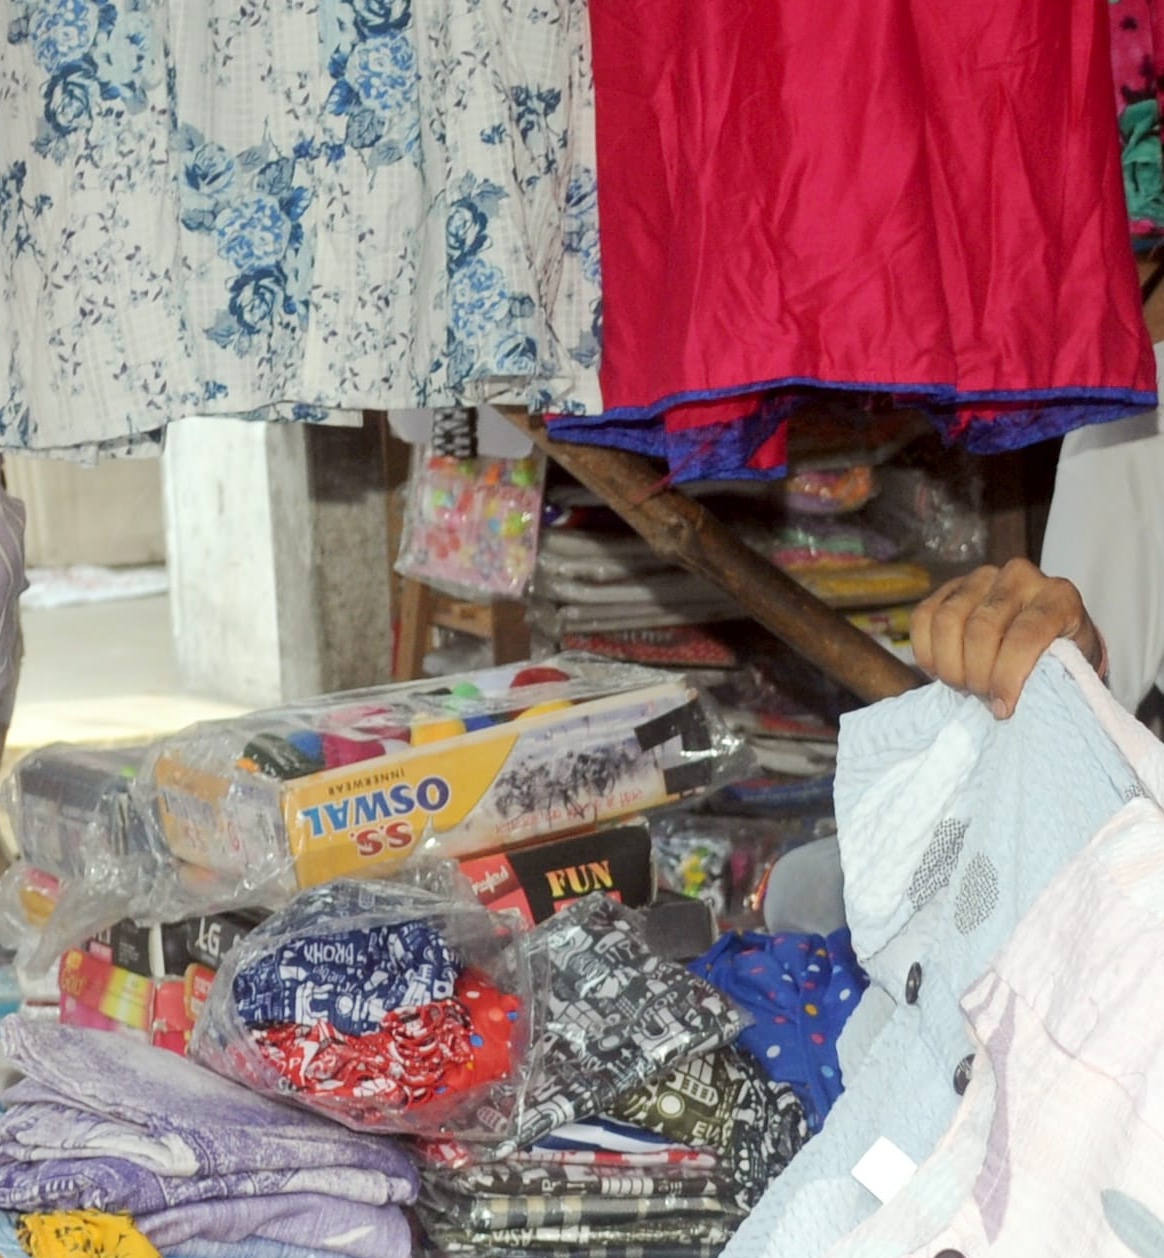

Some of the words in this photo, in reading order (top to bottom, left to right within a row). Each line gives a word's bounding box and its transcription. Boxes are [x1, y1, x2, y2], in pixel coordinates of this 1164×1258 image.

[327, 766, 405, 796] INNERWEAR
[298, 776, 449, 836] OSWAL
[545, 860, 613, 898] FUN
